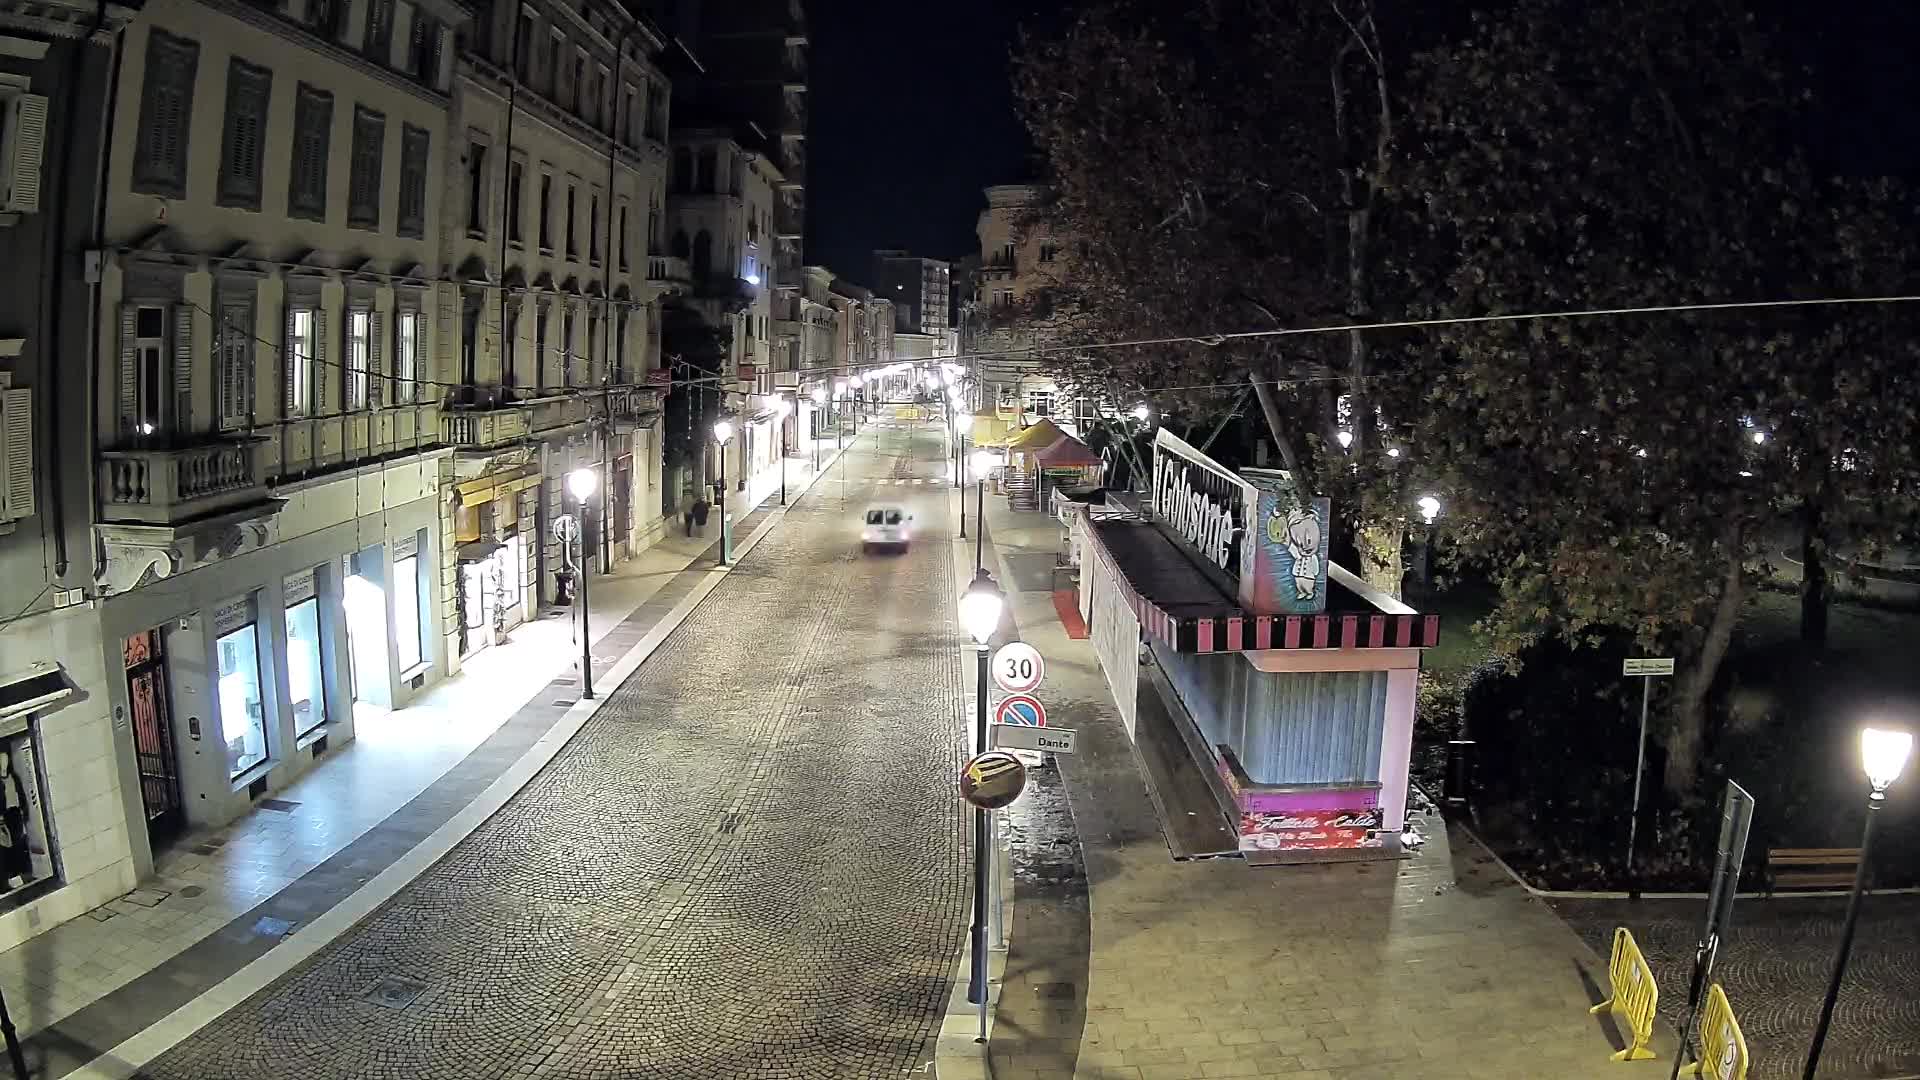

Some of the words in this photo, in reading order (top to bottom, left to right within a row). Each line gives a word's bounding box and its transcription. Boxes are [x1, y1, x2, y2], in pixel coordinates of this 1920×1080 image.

[1162, 458, 1233, 570] Golosone
[1006, 658, 1032, 679] 30
[1038, 737, 1070, 750] Dante
